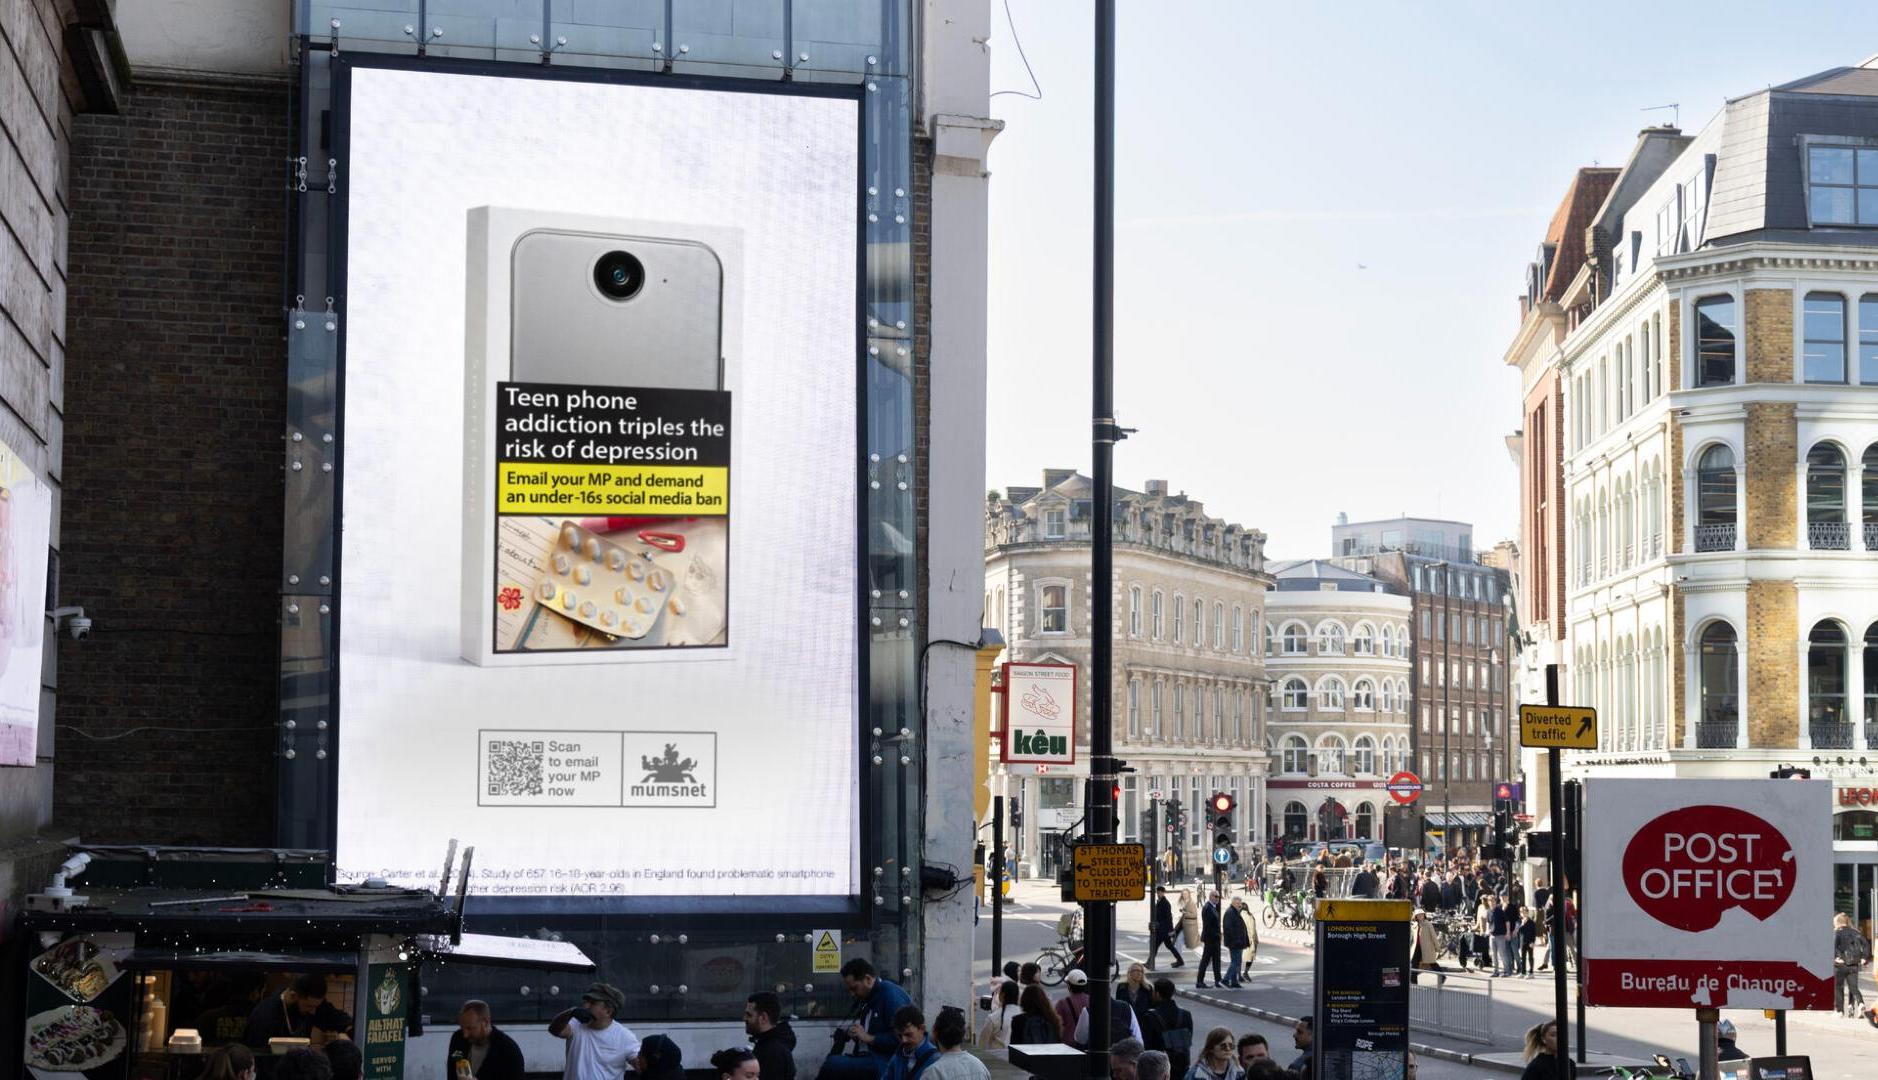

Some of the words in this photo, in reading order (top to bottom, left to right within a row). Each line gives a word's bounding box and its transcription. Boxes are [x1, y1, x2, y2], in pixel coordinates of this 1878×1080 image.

[505, 388, 560, 408] Teen
[567, 390, 637, 412] phone
[505, 414, 612, 434] addiction
[619, 417, 685, 439] triples
[691, 418, 725, 436] the
[505, 439, 545, 458] risk
[551, 440, 576, 459] of
[581, 440, 698, 463] depression
[507, 471, 548, 486] Email
[551, 474, 585, 488] your
[588, 473, 612, 486] MP
[615, 474, 642, 487] and
[645, 474, 704, 488] demand
[506, 492, 526, 503] an
[529, 490, 603, 504] under-16s
[606, 491, 645, 505] social
[649, 492, 692, 505] media
[696, 492, 722, 506] ban
[1525, 712, 1572, 726] Diverted
[1532, 728, 1567, 741] traffic
[549, 741, 581, 752] Scan
[1014, 729, 1067, 756] kêu
[548, 757, 562, 767] to
[565, 756, 599, 767] email
[548, 772, 577, 783] your
[580, 771, 601, 782] MP
[548, 787, 575, 797] now
[630, 783, 707, 798] mumsnet
[1081, 847, 1092, 856] ST
[1096, 847, 1139, 856] THOMAS
[1664, 833, 1761, 863] POST
[1091, 857, 1128, 866] STREET
[481, 868, 511, 881] Study
[514, 868, 524, 879] of
[526, 868, 545, 879] 657
[634, 869, 642, 878] in
[644, 868, 687, 881] England
[687, 868, 715, 879] found
[717, 868, 775, 881] problematic
[777, 868, 836, 881] smartphone
[1089, 868, 1130, 877] CLOSED
[492, 883, 547, 895] depression
[550, 882, 567, 893] risk
[1077, 879, 1090, 888] TO
[1094, 879, 1143, 888] THROUGH
[1640, 868, 1775, 900] OFFICE
[1090, 889, 1131, 898] TRAFFIC
[1621, 972, 1690, 991] Bureau
[1697, 973, 1720, 991] de
[1726, 973, 1798, 995] Change
[367, 1030, 404, 1044] FALAFEL
